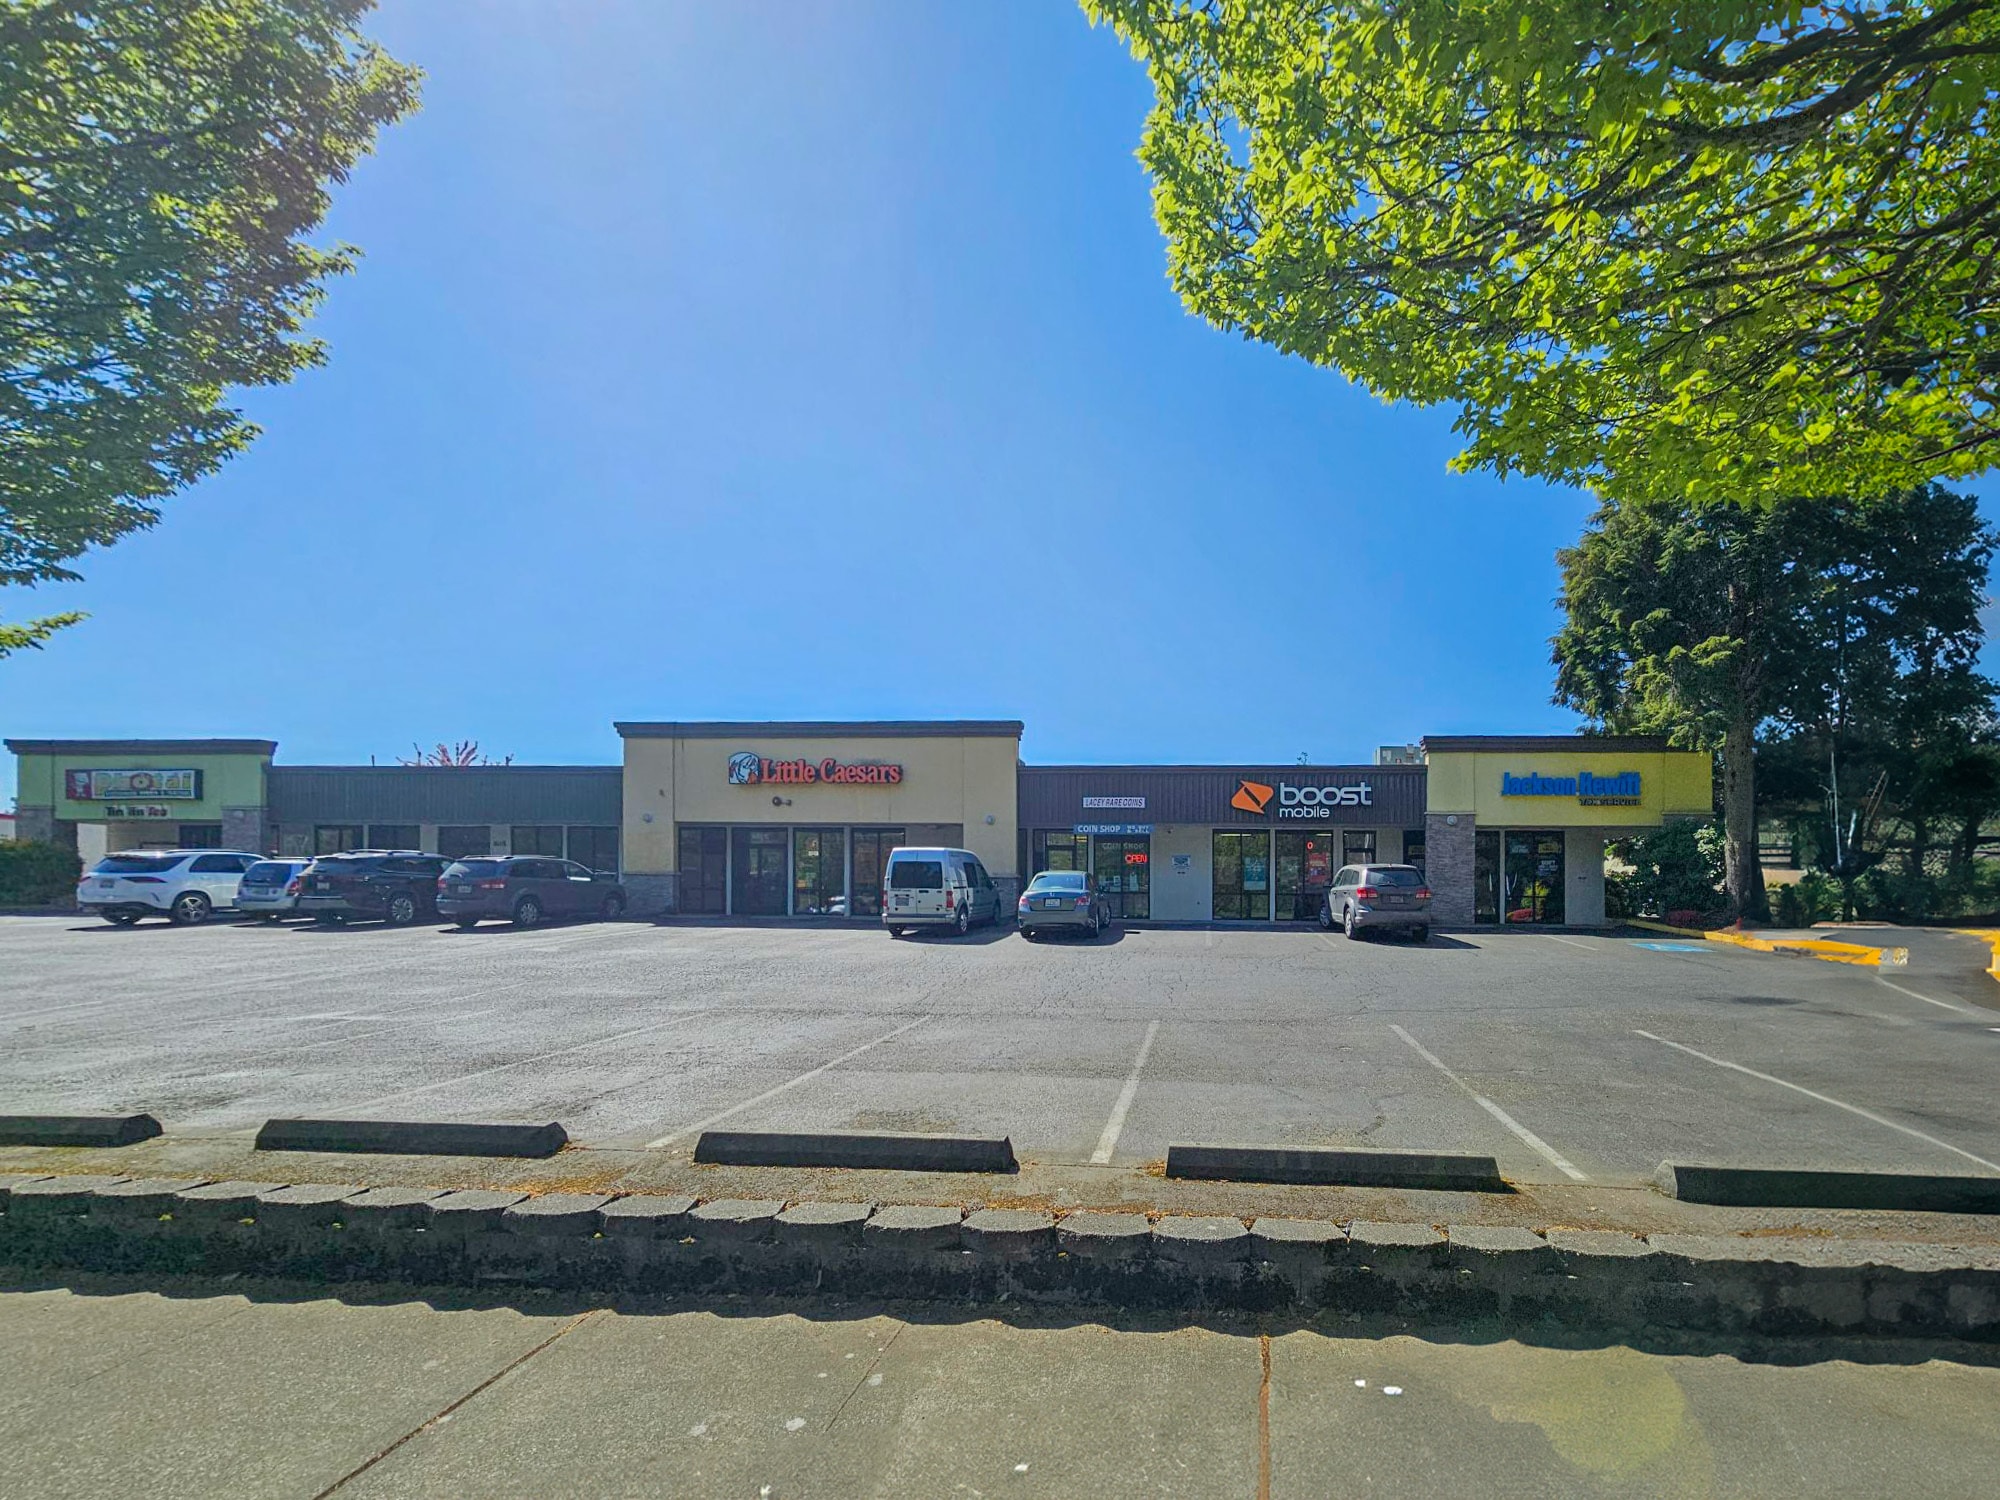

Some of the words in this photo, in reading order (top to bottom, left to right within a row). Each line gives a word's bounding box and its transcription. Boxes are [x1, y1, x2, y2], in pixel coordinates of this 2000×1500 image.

[761, 758, 815, 784] Little
[819, 758, 902, 784] Caesars
[1501, 771, 1576, 796] Jackson
[1579, 771, 1641, 796] Hewitt
[1280, 782, 1372, 805] boost
[1086, 798, 1105, 807] LACEY
[1106, 798, 1122, 807] RARE
[1123, 798, 1143, 807] COINS
[1280, 806, 1330, 818] mobile
[1077, 825, 1098, 833] COIN
[1100, 825, 1121, 833] SHOP
[1125, 854, 1147, 864] OPEN
